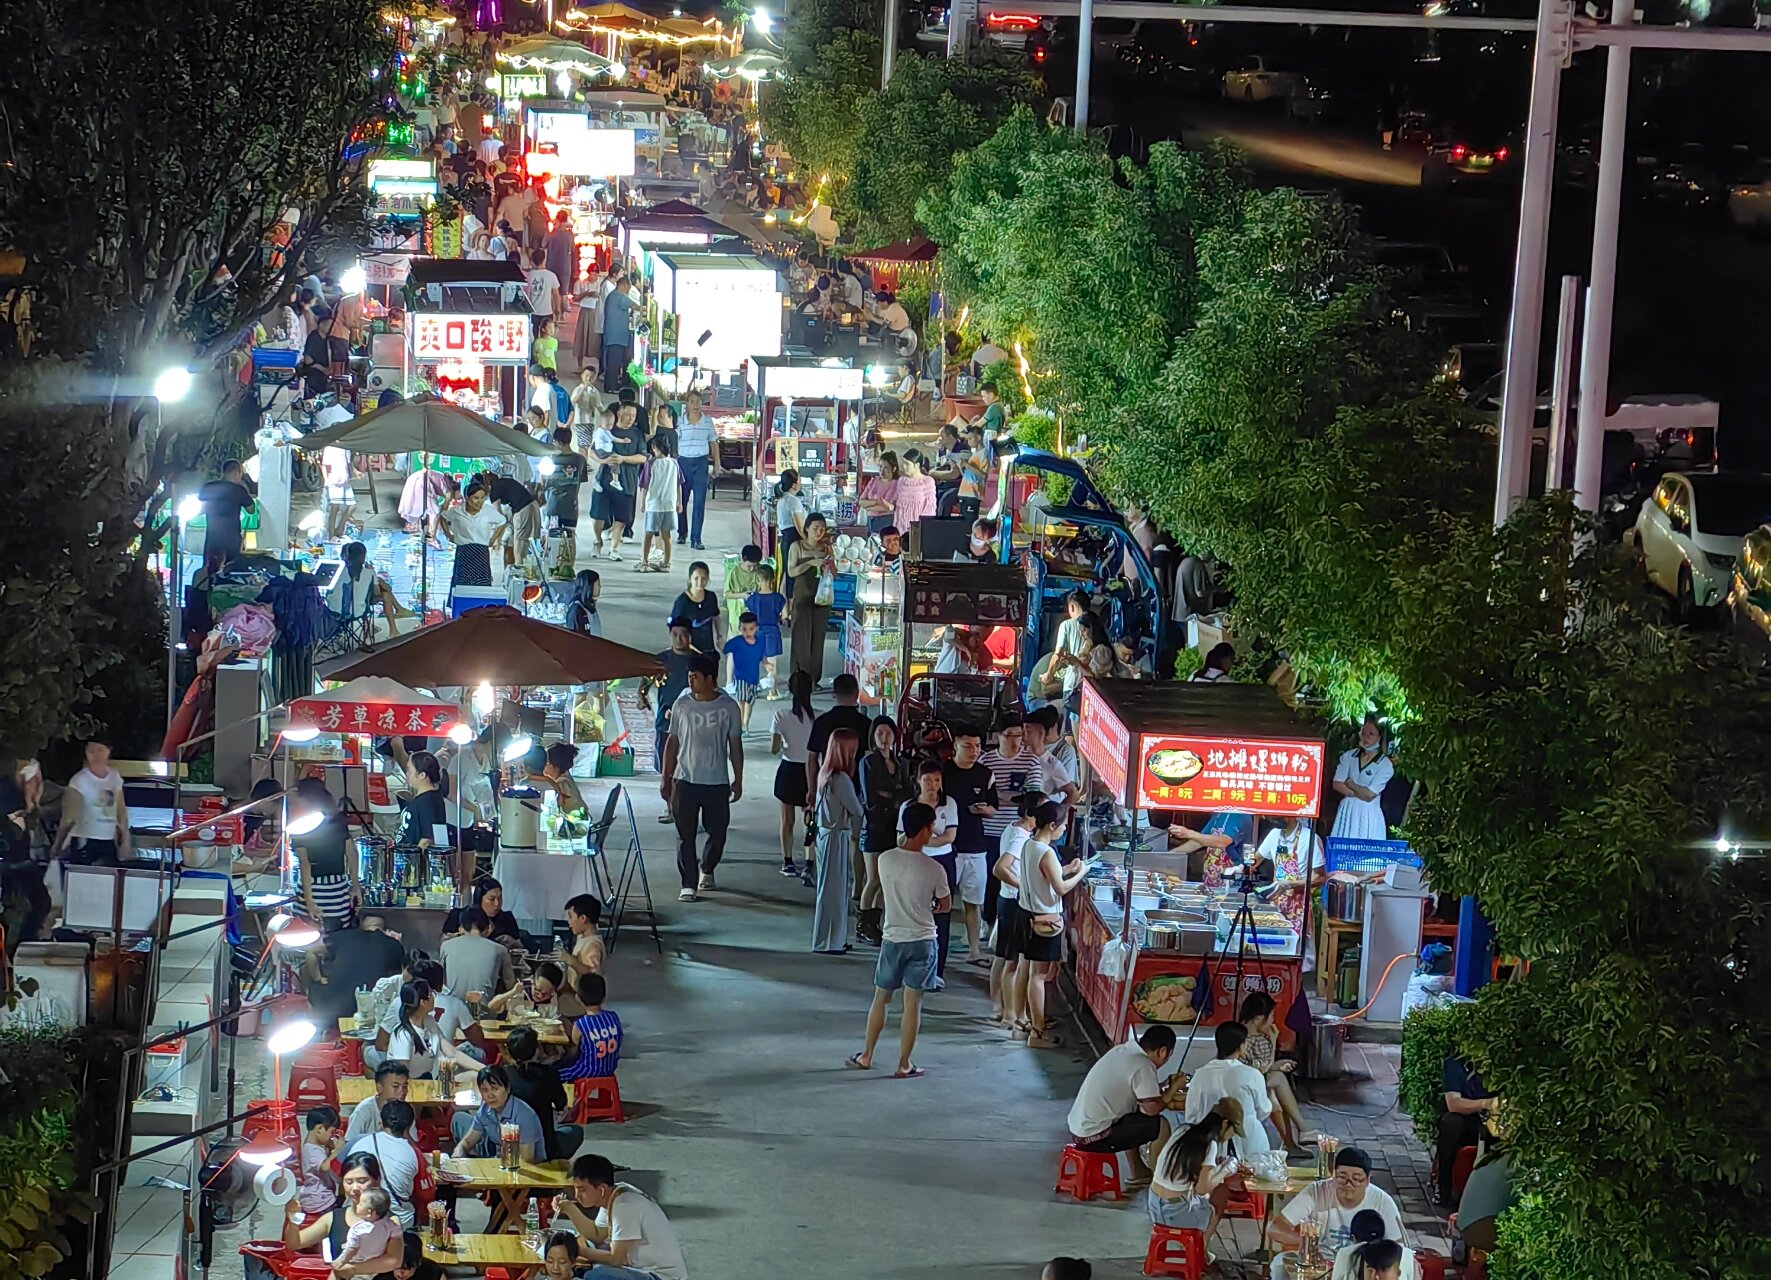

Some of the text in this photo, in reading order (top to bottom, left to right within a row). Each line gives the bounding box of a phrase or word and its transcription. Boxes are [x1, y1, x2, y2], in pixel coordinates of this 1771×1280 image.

[420, 318, 524, 353] 爽口酸嘢
[321, 703, 428, 732] 芳草凉茶
[1207, 748, 1310, 773] 地摊螺蛳粉
[595, 1038, 618, 1059] 30
